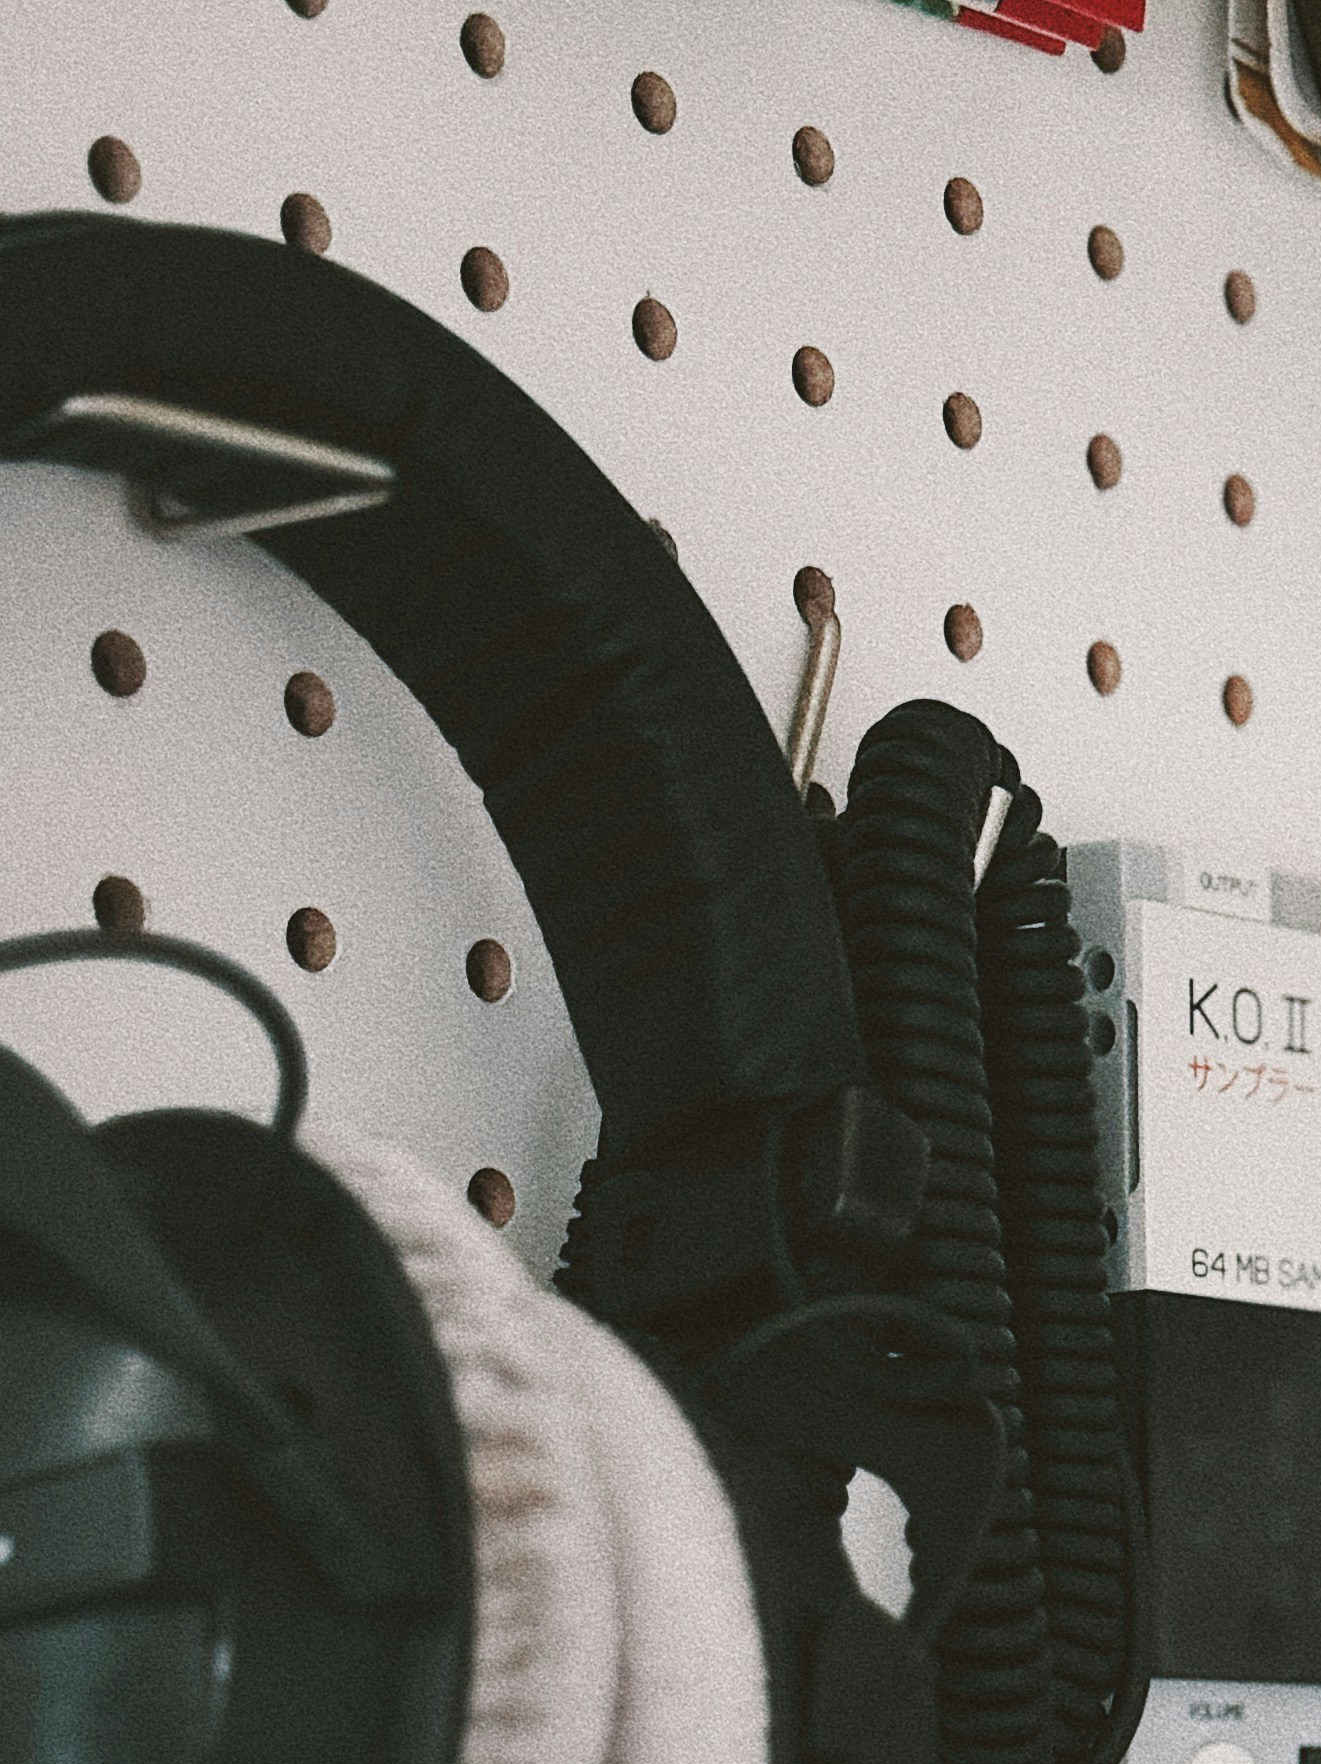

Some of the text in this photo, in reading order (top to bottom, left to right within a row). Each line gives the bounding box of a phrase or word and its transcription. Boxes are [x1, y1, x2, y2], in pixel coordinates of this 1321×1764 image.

[1199, 871, 1260, 898] OUTPUT
[1187, 1055, 1317, 1105] サンプラー
[1190, 1246, 1227, 1279] 64
[1234, 1252, 1271, 1287] MB
